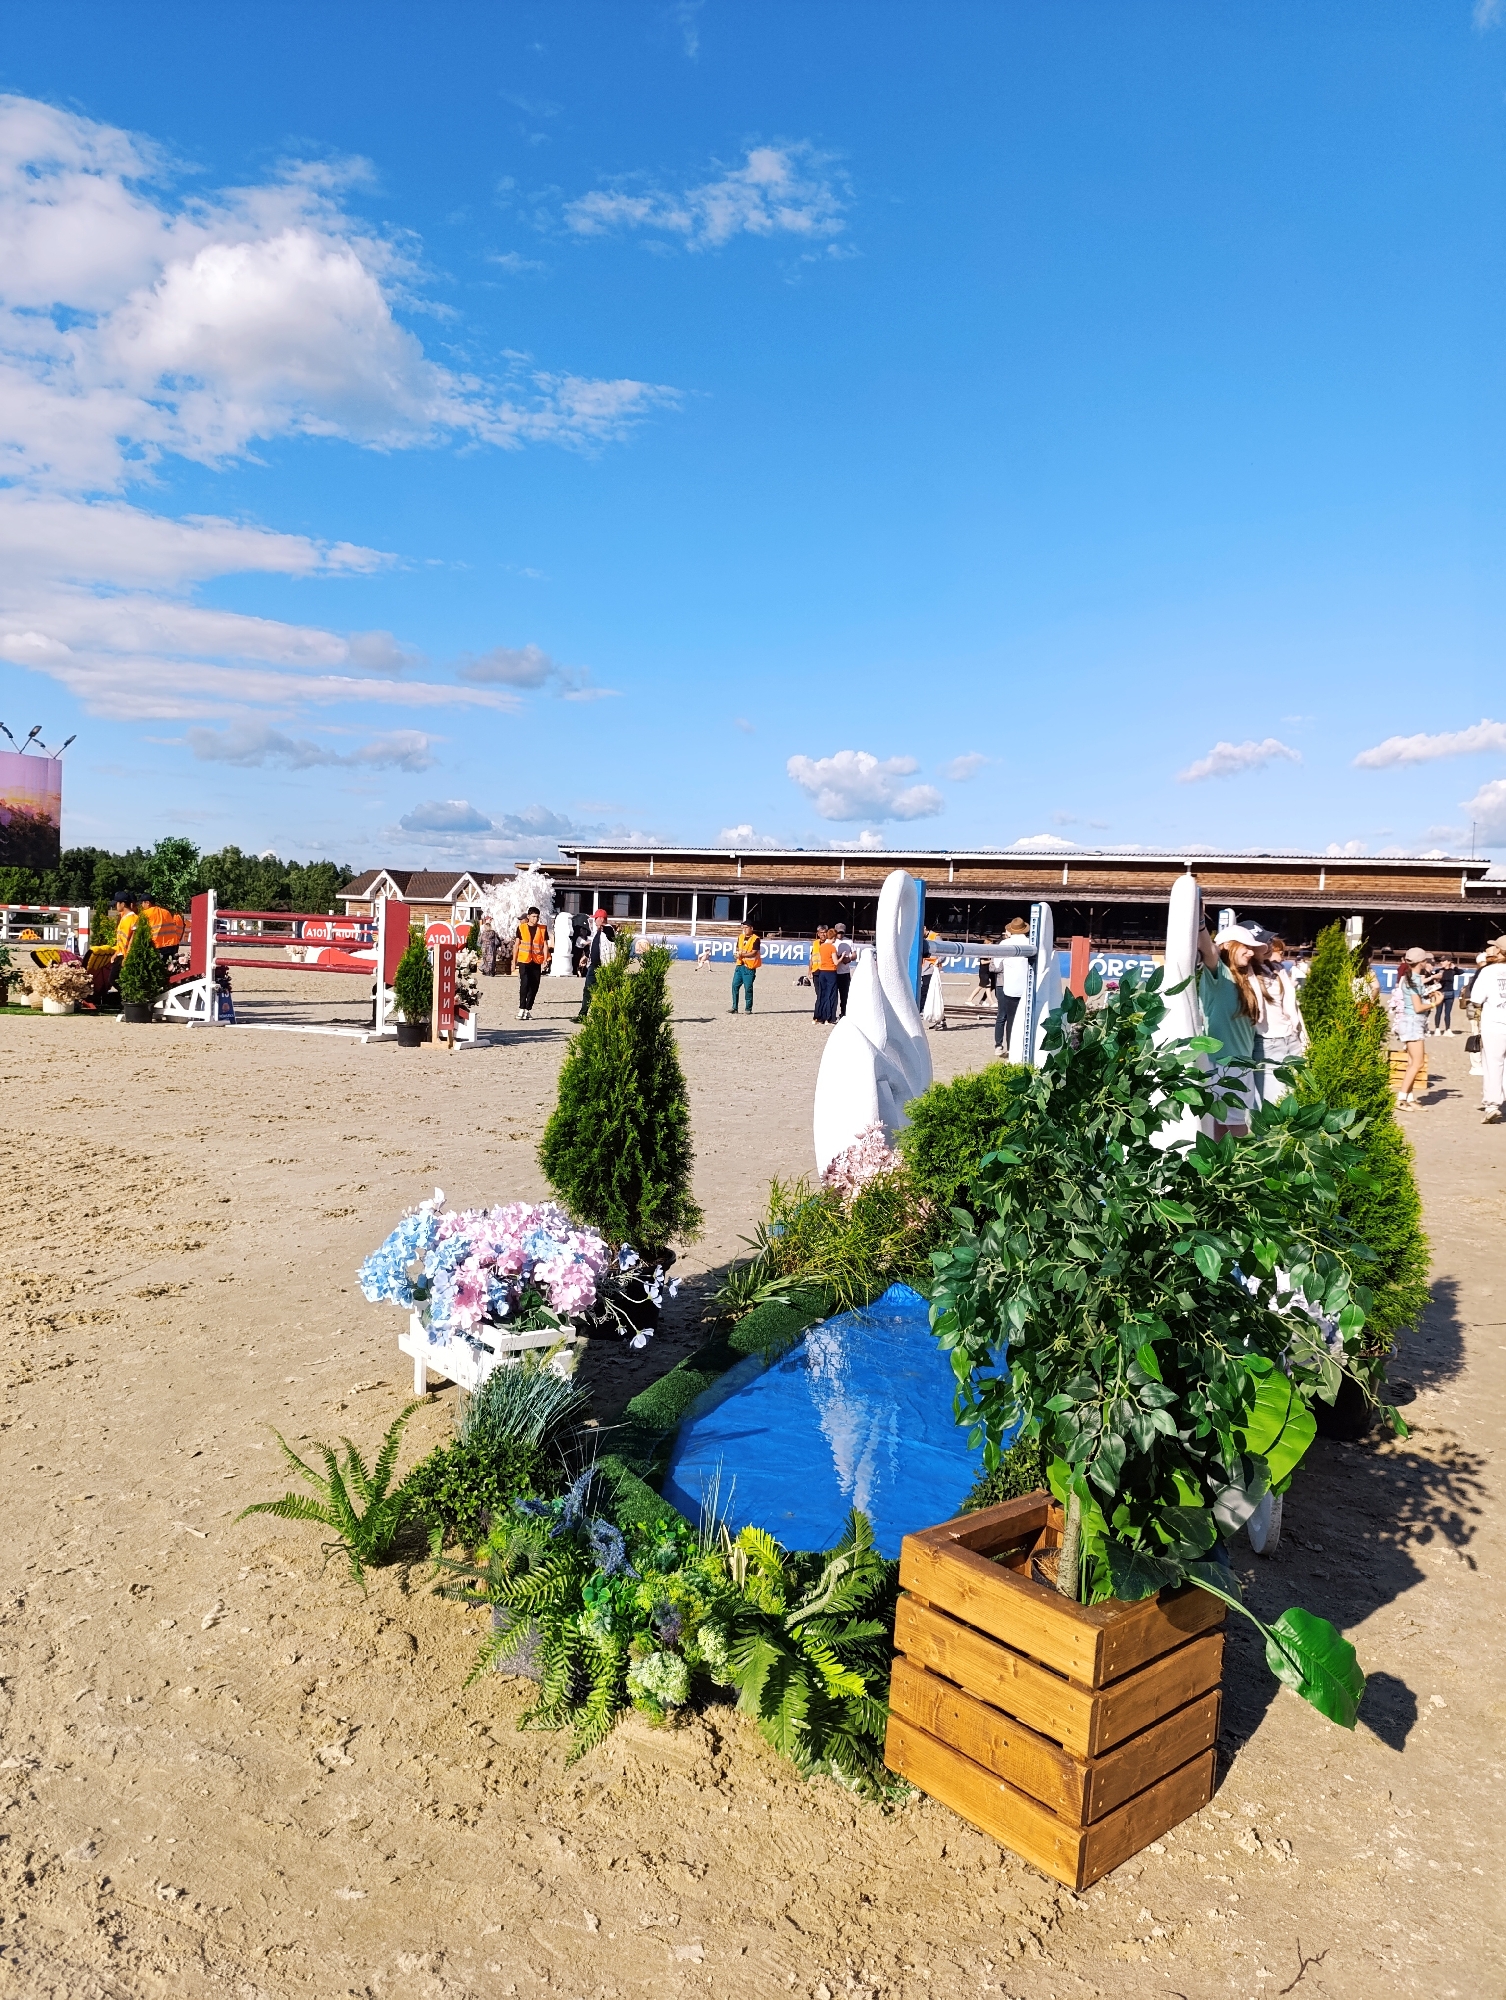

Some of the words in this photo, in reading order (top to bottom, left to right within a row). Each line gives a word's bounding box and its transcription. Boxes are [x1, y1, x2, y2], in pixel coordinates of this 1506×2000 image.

[306, 928, 327, 938] A101
[427, 934, 451, 944] A101
[692, 940, 804, 960] ТЕРРОРИЯ
[441, 949, 453, 1025] ФИНИШ
